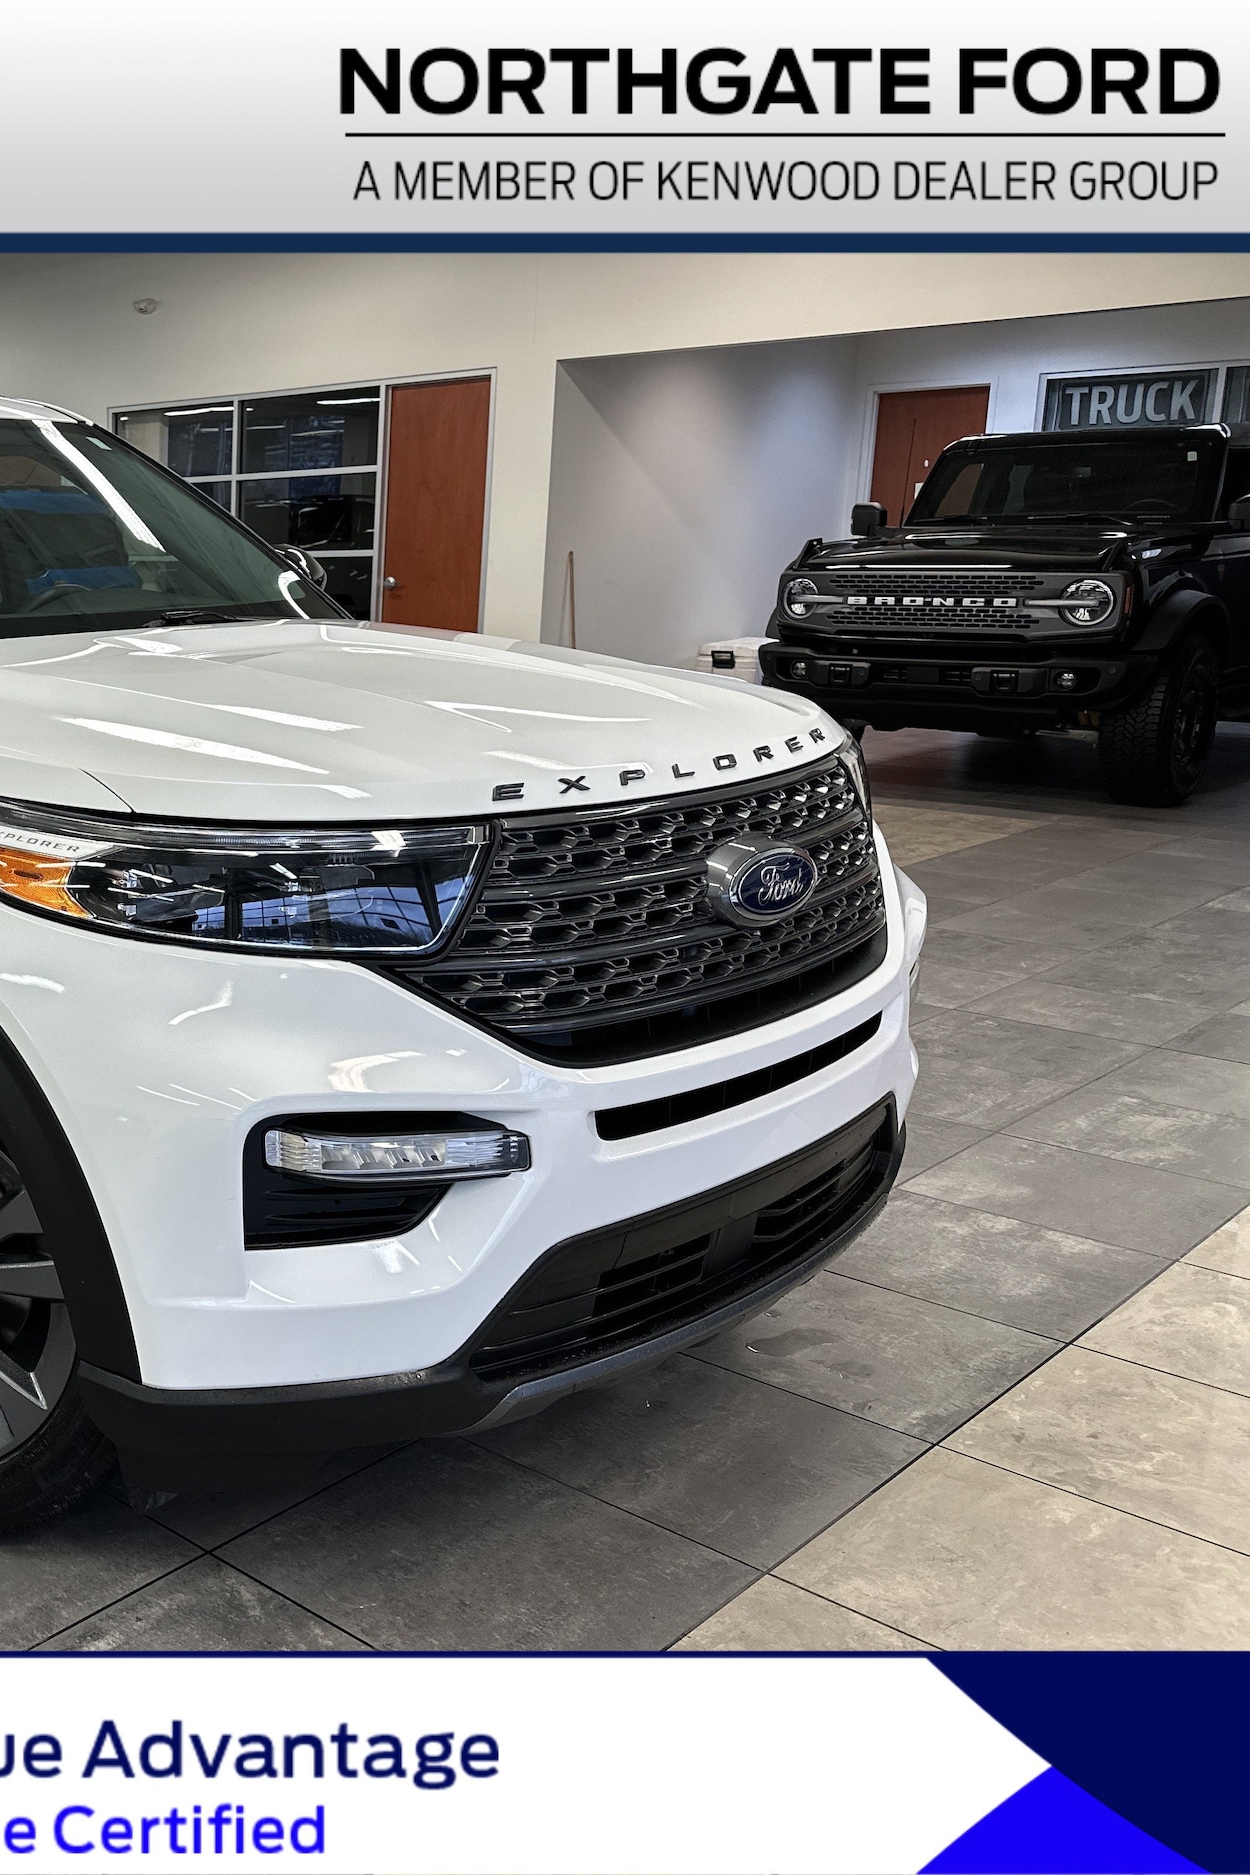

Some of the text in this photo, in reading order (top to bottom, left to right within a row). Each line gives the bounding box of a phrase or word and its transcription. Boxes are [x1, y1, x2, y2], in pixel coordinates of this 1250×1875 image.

[1065, 379, 1200, 425] TRUCK
[847, 596, 1017, 607] BRONCO
[492, 727, 826, 802] EXPLORER
[758, 862, 804, 906] Ford
